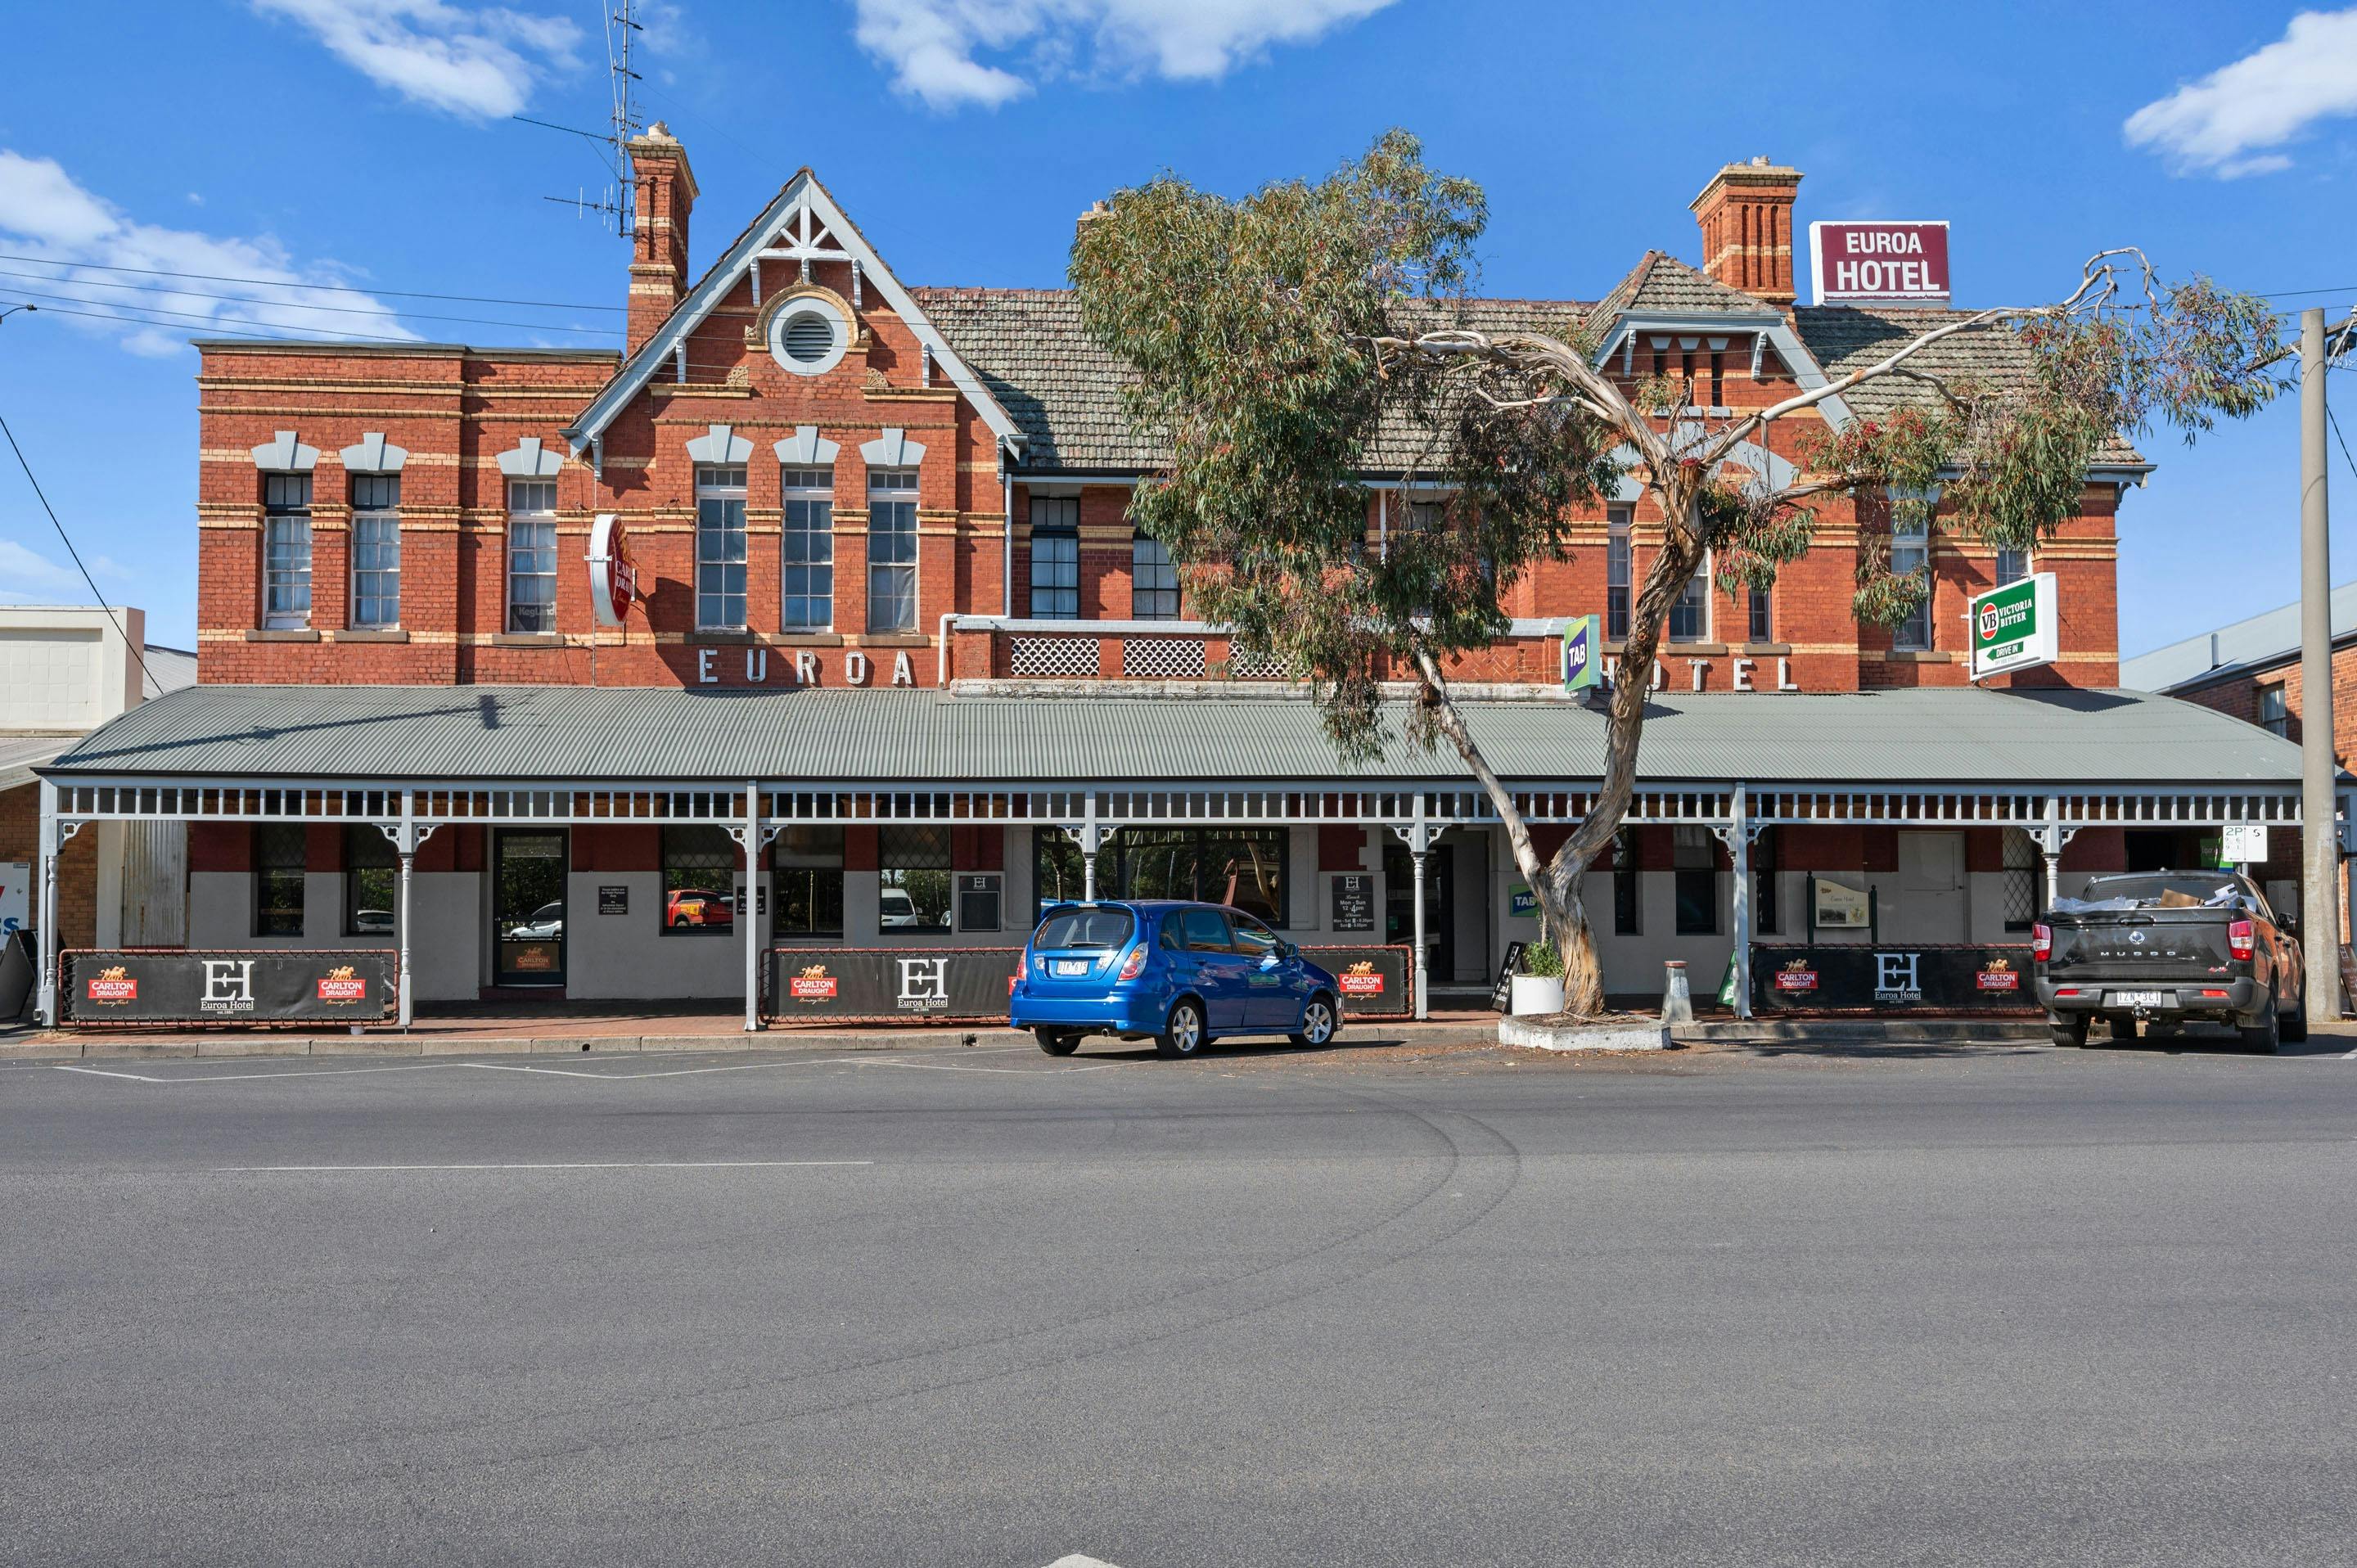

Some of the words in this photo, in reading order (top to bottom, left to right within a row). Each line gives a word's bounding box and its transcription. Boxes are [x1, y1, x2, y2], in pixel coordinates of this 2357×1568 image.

[1845, 232, 1922, 254] EUROA
[1836, 260, 1940, 291] HOTEL
[518, 606, 554, 618] KegLand
[1999, 598, 2032, 617] VICTORIA
[1981, 613, 1997, 630] VB
[2000, 611, 2026, 628] BITTER
[1569, 643, 1585, 667] TAB
[1996, 647, 2012, 658] DRIVE
[2012, 644, 2018, 653] IN
[699, 649, 913, 685] EUROA
[2226, 827, 2243, 836] 2P
[92, 982, 133, 990] CARLTON
[321, 982, 362, 990] CARLTON
[201, 1001, 228, 1009] Euroa
[230, 1001, 254, 1009] Hotel
[897, 998, 923, 1007] Euroa
[926, 998, 949, 1007] Hotel
